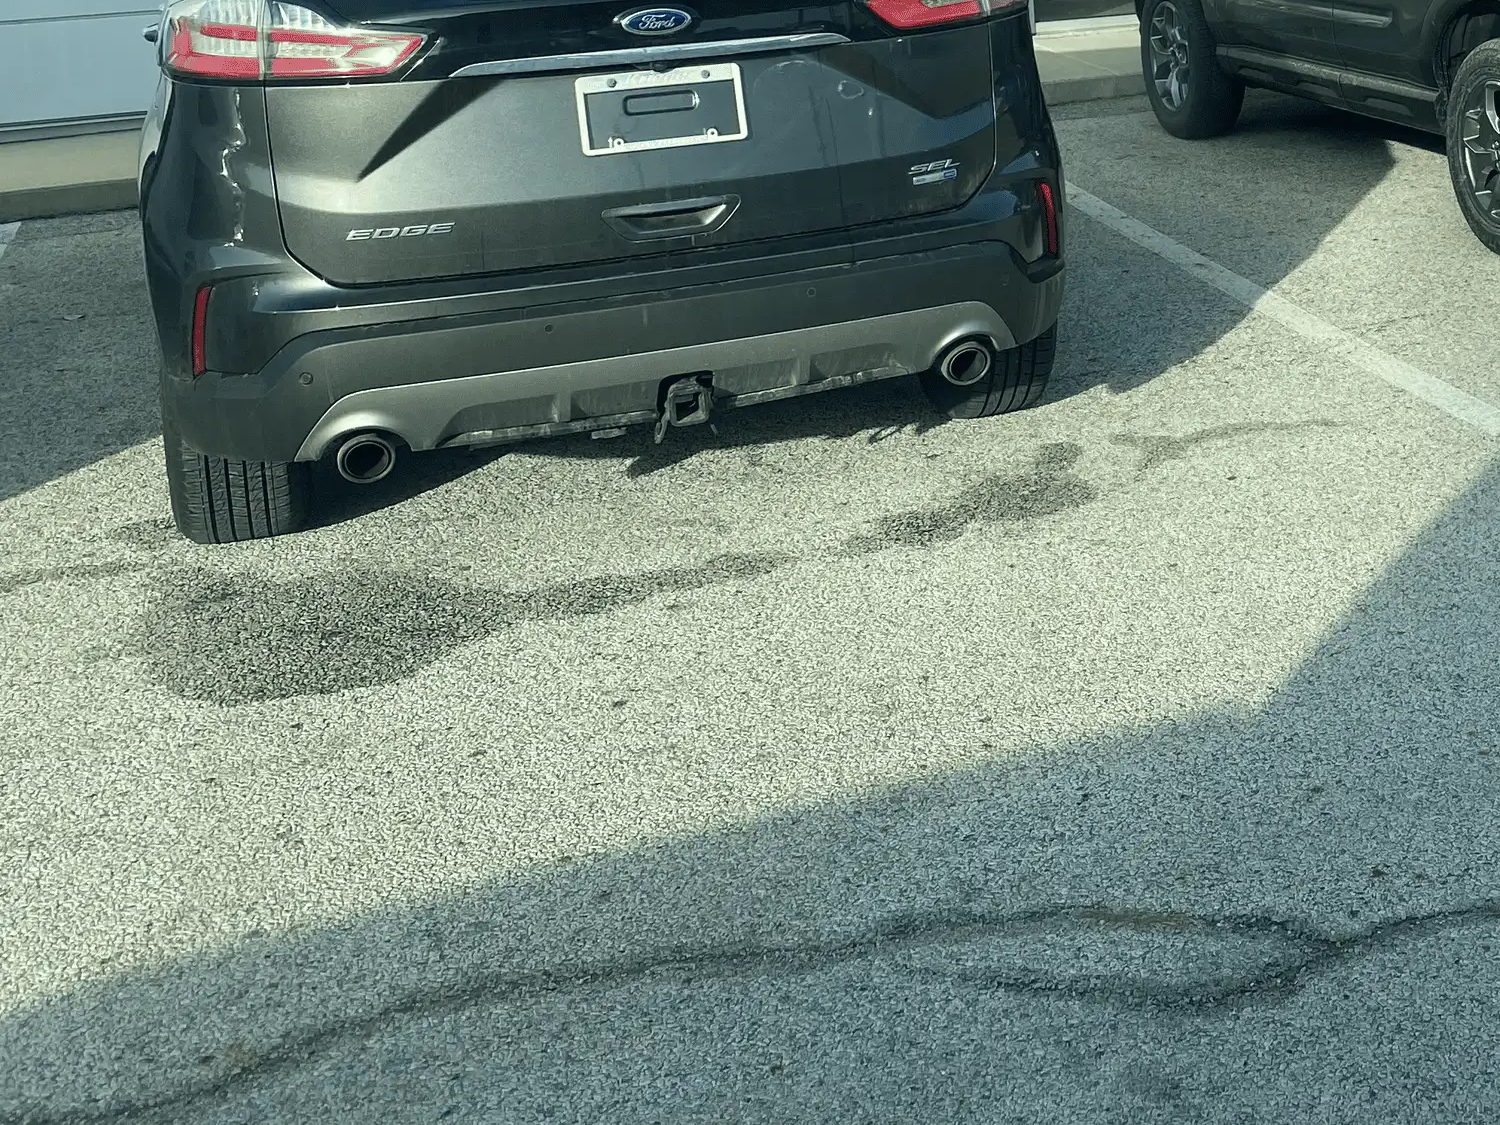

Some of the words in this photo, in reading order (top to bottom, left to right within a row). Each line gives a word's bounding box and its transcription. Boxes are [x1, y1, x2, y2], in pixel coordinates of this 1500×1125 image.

[638, 13, 676, 30] Ford
[908, 158, 961, 175] SEL
[345, 222, 456, 242] EDGE
